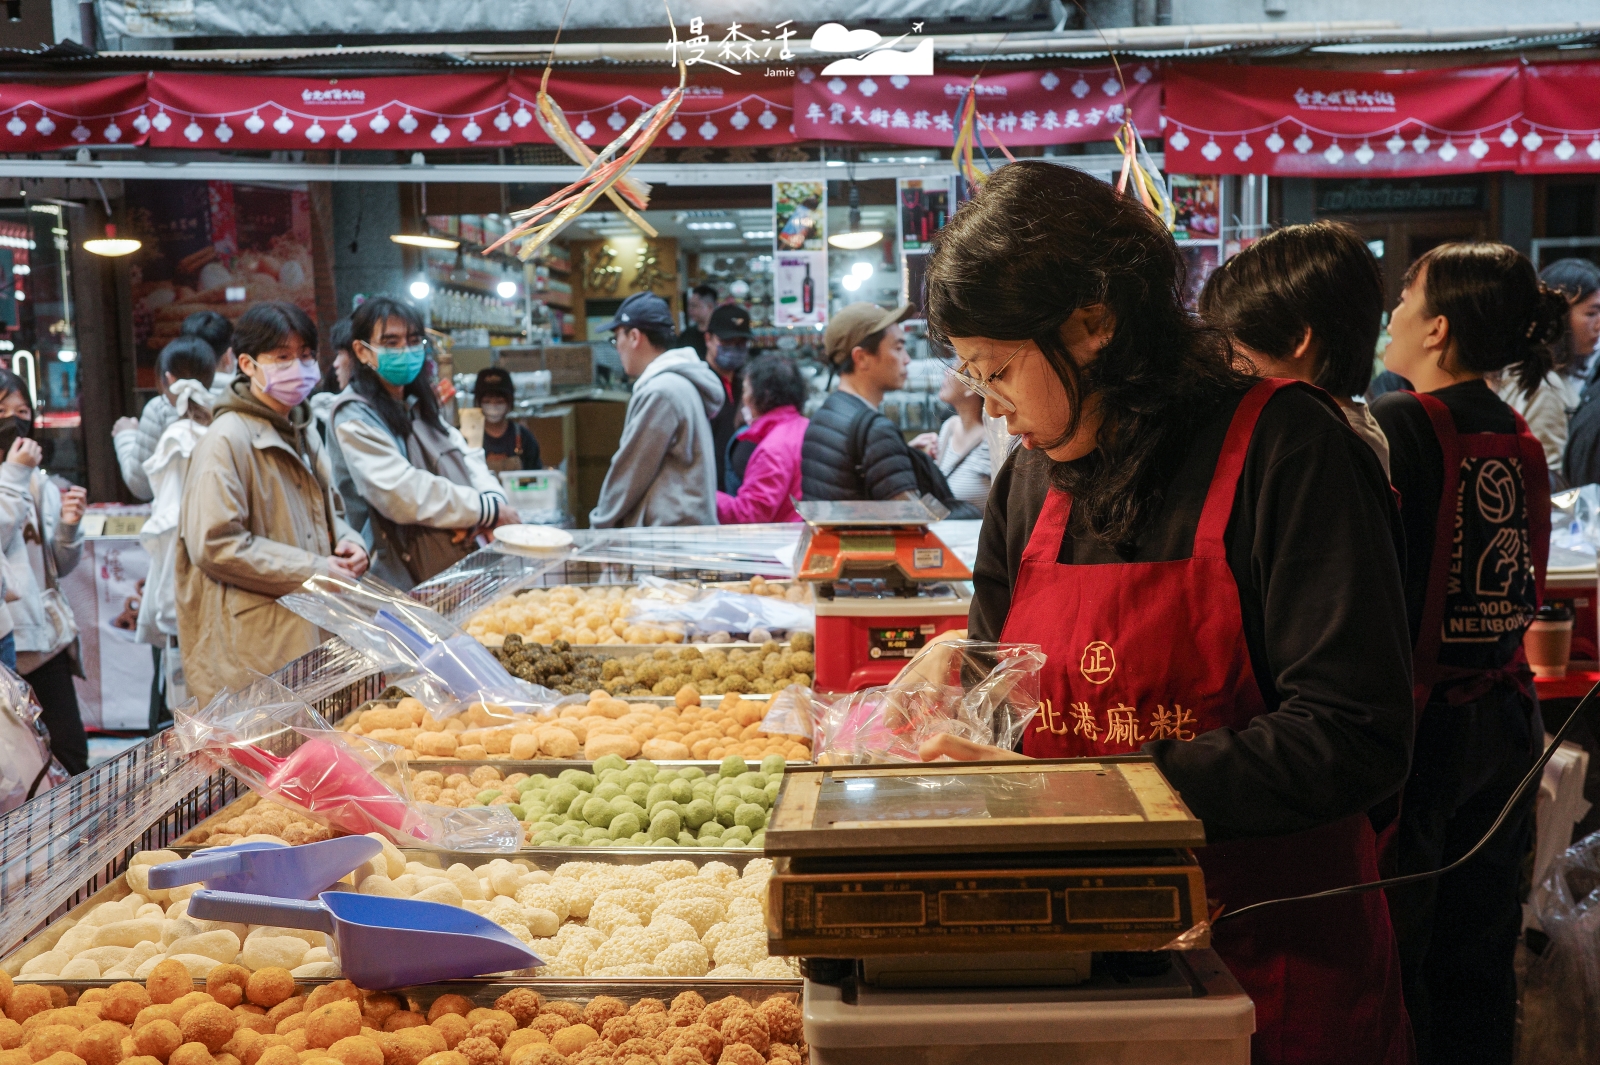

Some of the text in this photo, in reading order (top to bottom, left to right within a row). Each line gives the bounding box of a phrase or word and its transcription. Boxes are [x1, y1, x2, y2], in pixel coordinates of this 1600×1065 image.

[1083, 644, 1111, 675] 正
[1034, 698, 1198, 747] 北港麻粩
